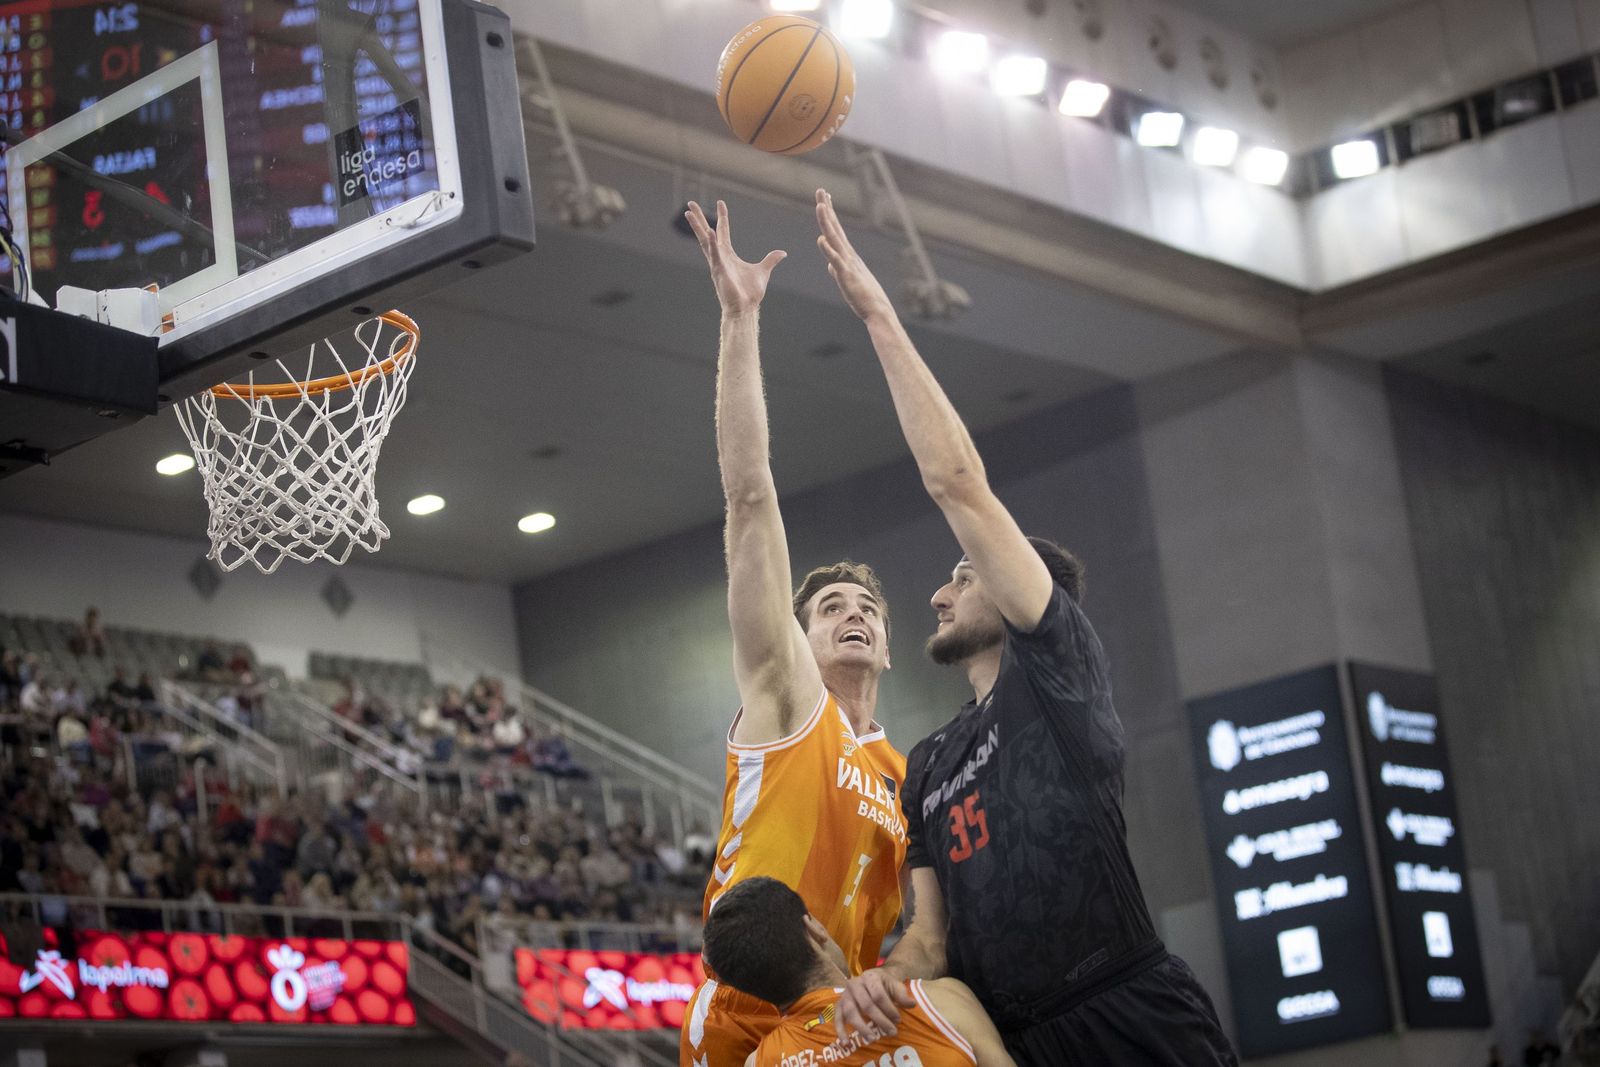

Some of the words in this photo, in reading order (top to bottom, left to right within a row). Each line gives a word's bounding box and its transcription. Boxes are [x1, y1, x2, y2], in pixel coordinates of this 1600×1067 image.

[341, 146, 376, 175] liga
[344, 149, 422, 197] endesa
[949, 790, 990, 864] 35
